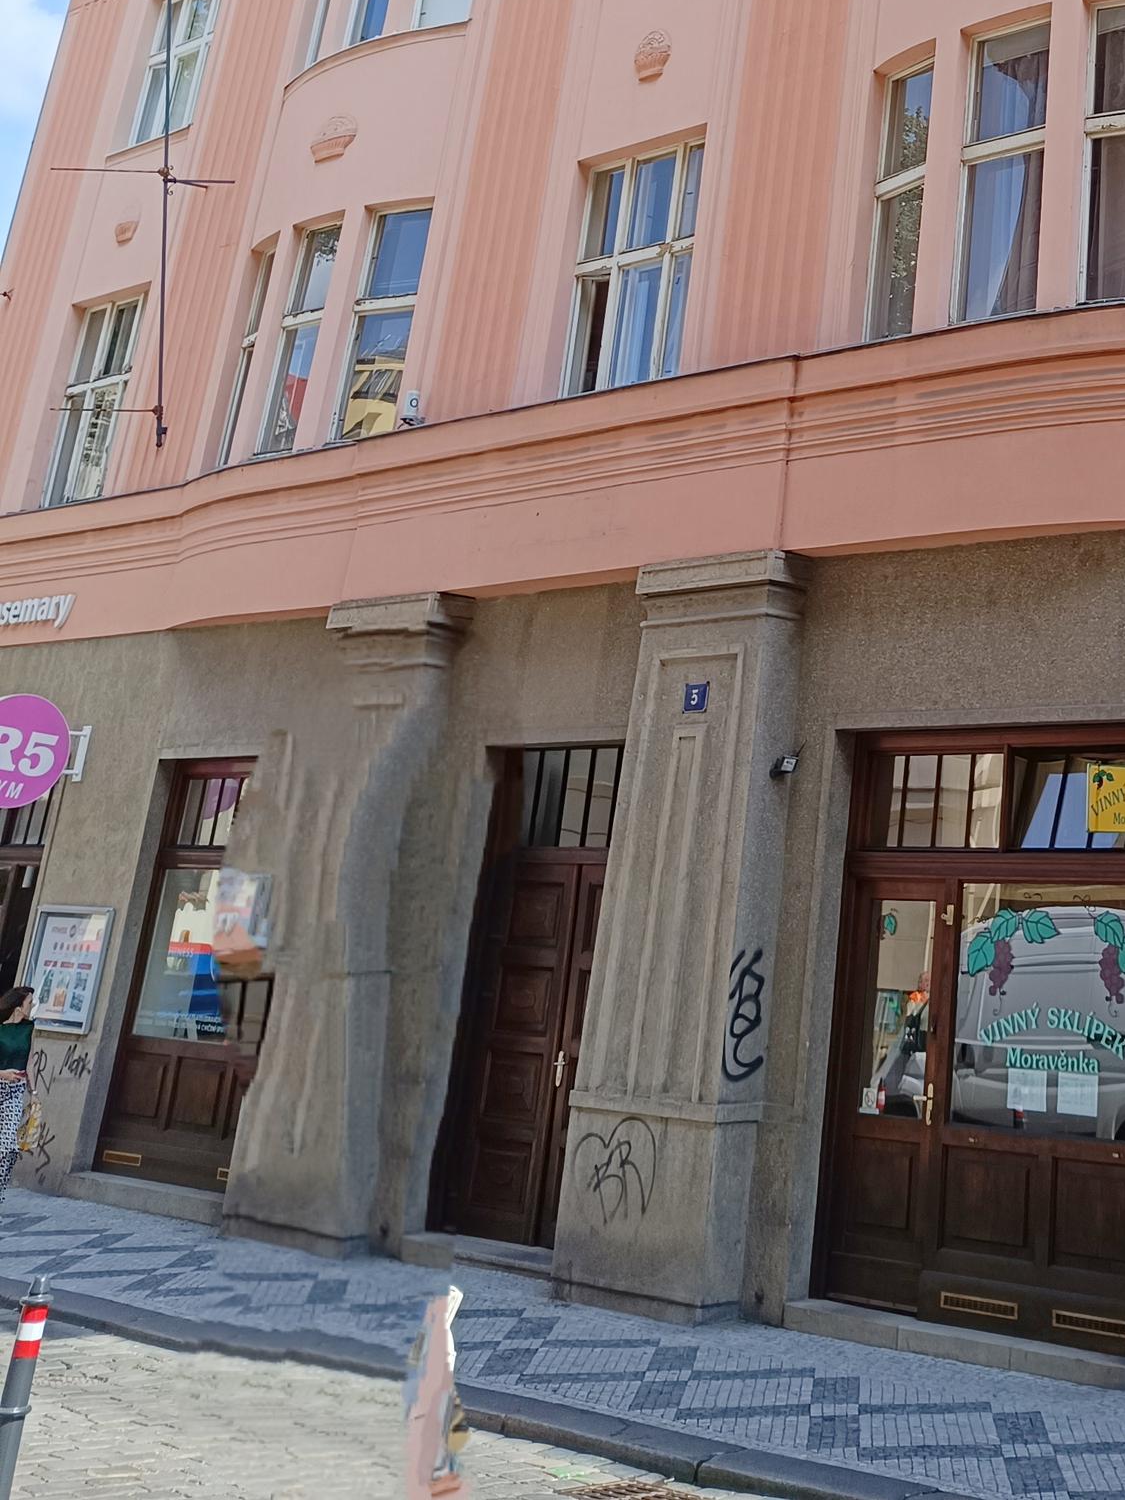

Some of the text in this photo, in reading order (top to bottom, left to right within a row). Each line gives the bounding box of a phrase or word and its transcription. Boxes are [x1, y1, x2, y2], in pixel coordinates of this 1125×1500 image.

[0, 594, 76, 628] semary
[690, 689, 699, 705] 5
[979, 1001, 1040, 1046] VINNÝ
[1005, 1046, 1099, 1075] Moravěnka
